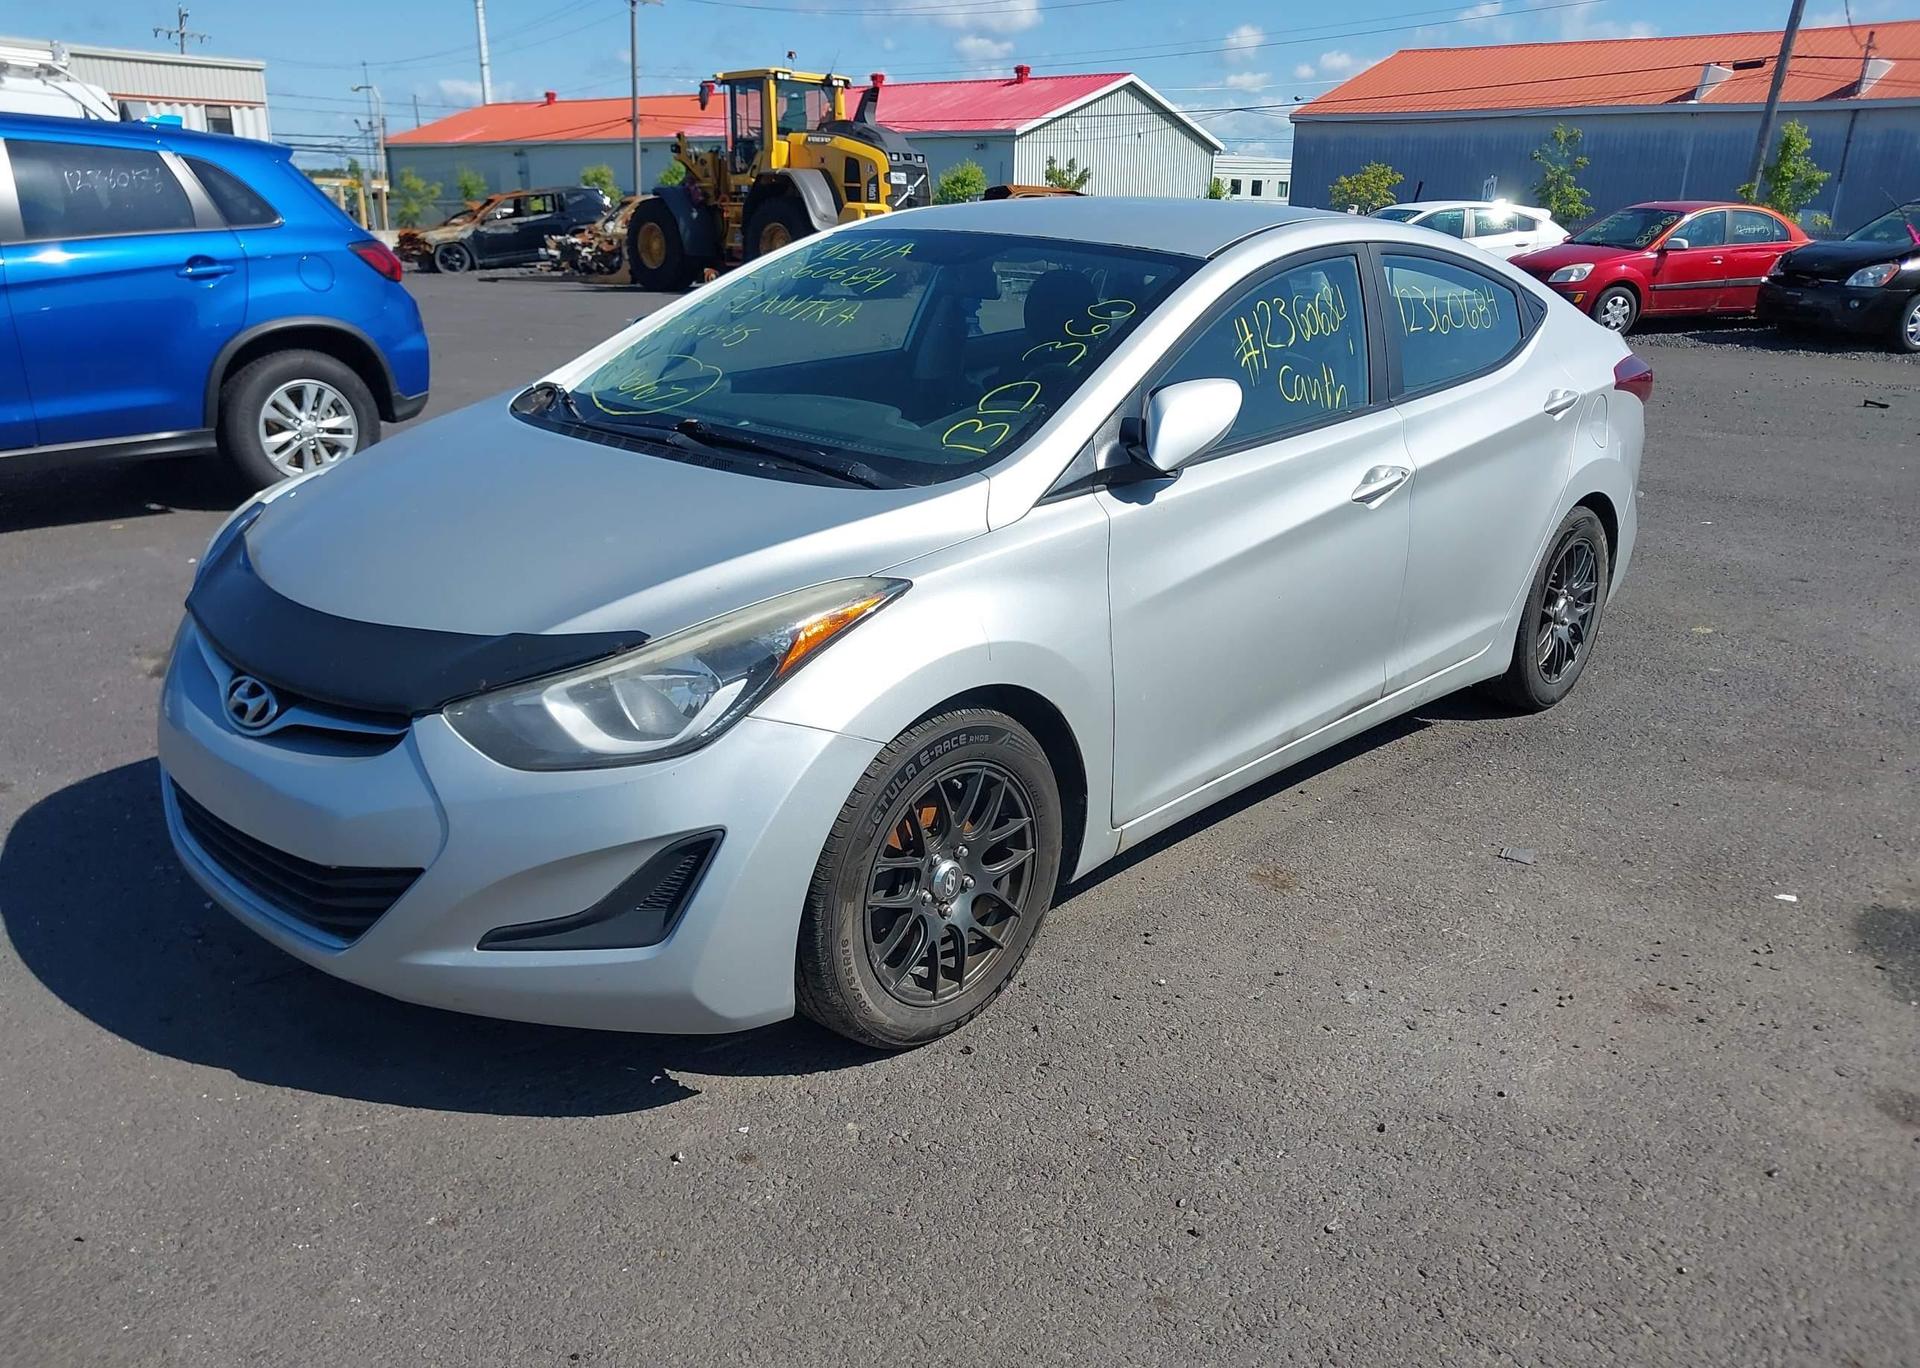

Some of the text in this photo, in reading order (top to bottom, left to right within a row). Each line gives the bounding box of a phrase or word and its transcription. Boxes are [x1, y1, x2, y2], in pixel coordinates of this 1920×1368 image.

[1022, 299, 1137, 368] 360
[1394, 283, 1501, 338] 12360684
[920, 733, 967, 767] E-RACE
